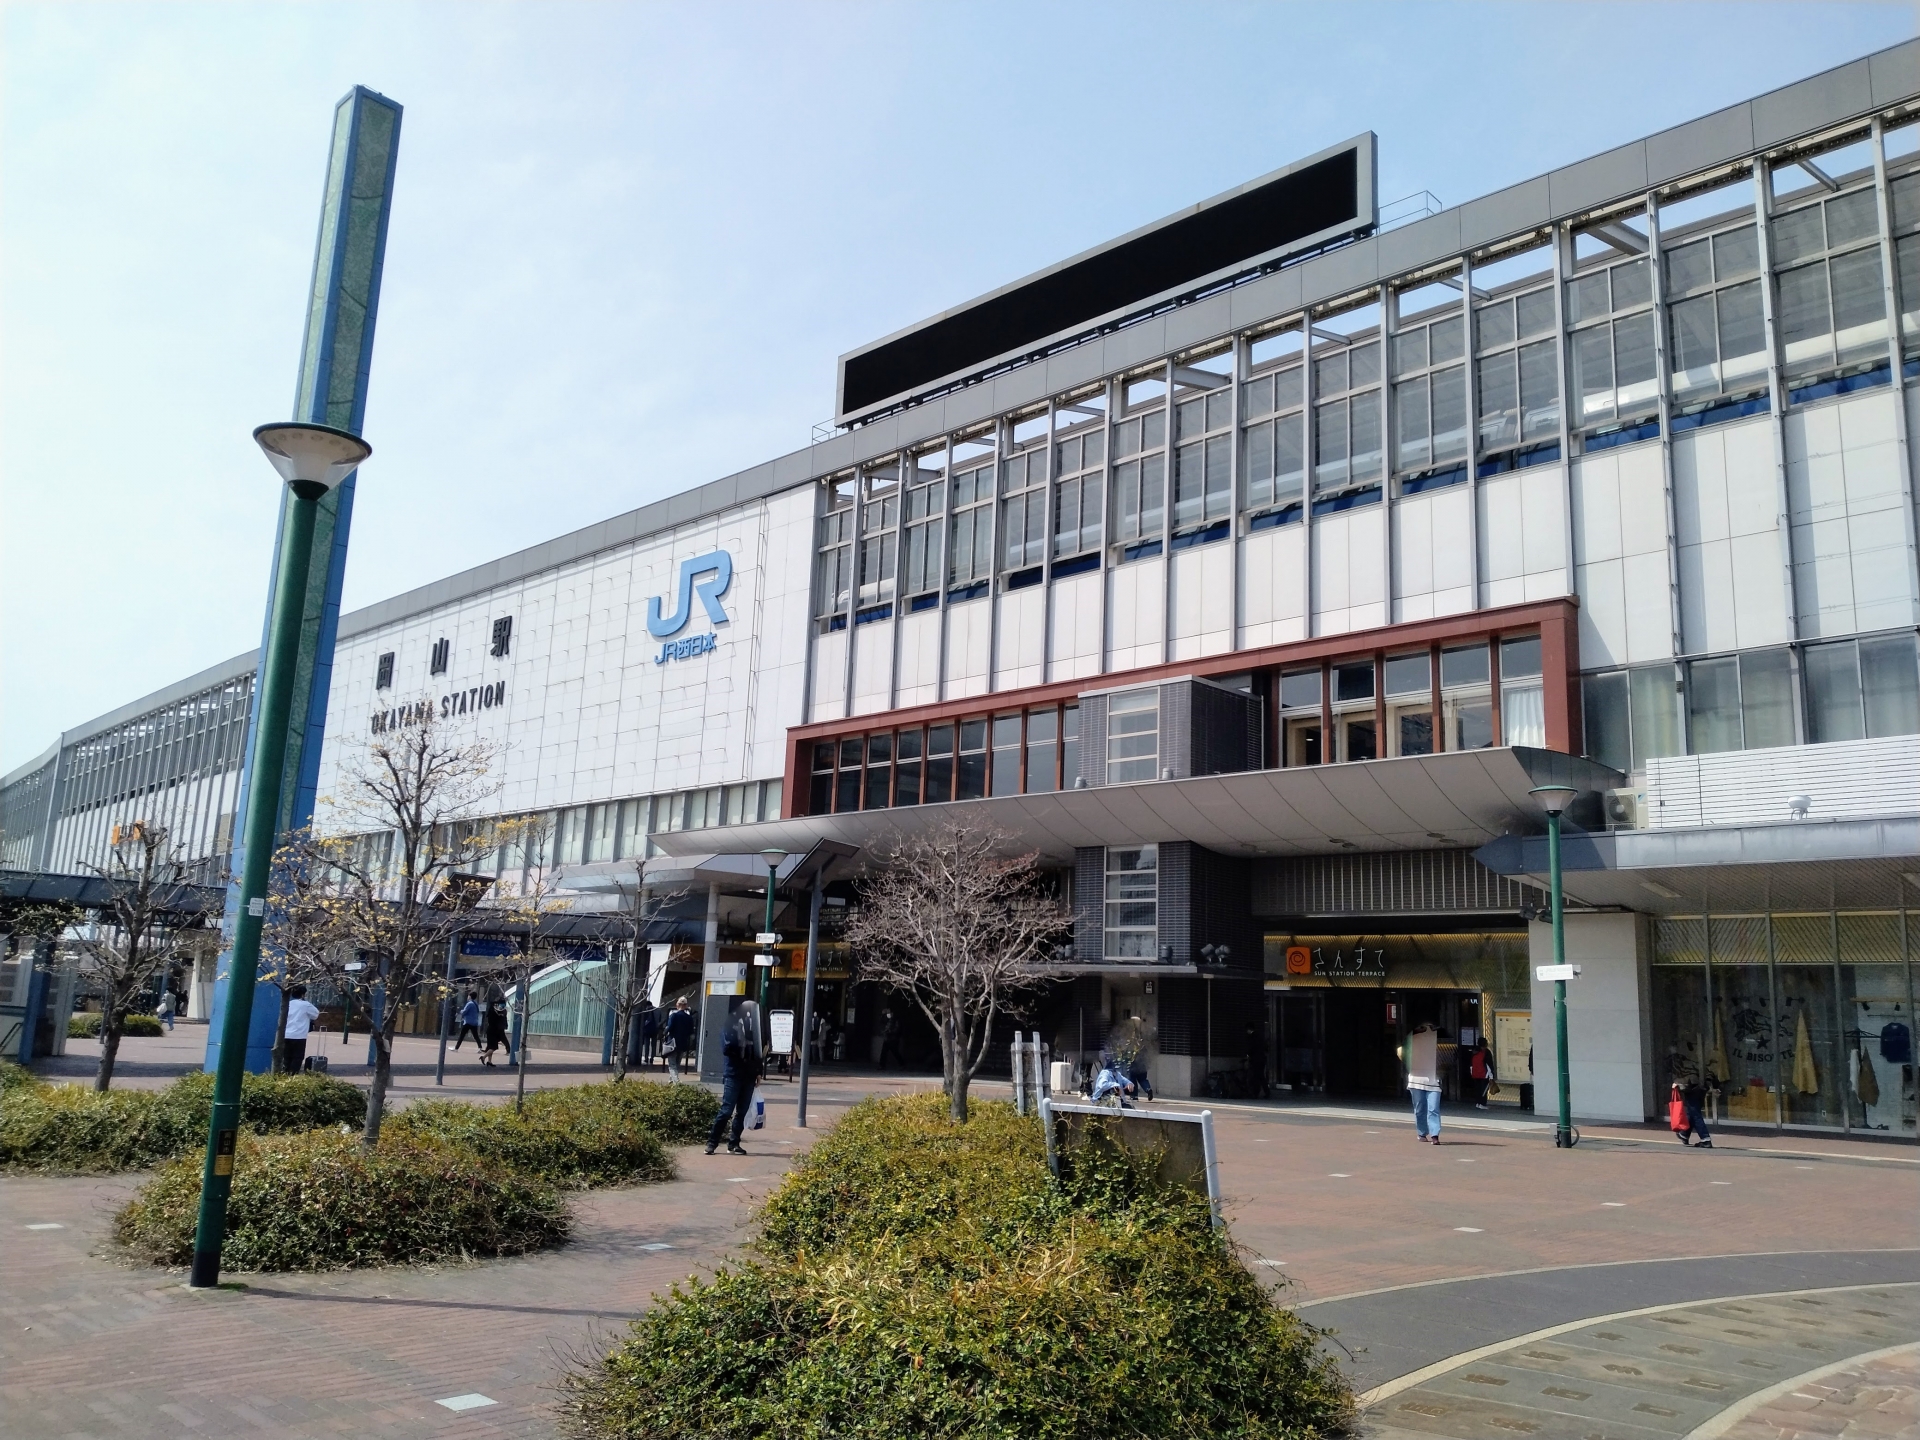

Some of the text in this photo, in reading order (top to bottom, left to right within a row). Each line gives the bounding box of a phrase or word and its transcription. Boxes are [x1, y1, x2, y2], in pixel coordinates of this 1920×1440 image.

[647, 549, 732, 637] JR
[376, 615, 513, 690] 岡山駅
[654, 632, 717, 665] JR西日本
[371, 681, 505, 735] OKAYAMA STATION
[1314, 947, 1384, 969] さんすて
[1733, 1048, 1795, 1062] IL BISOTE
